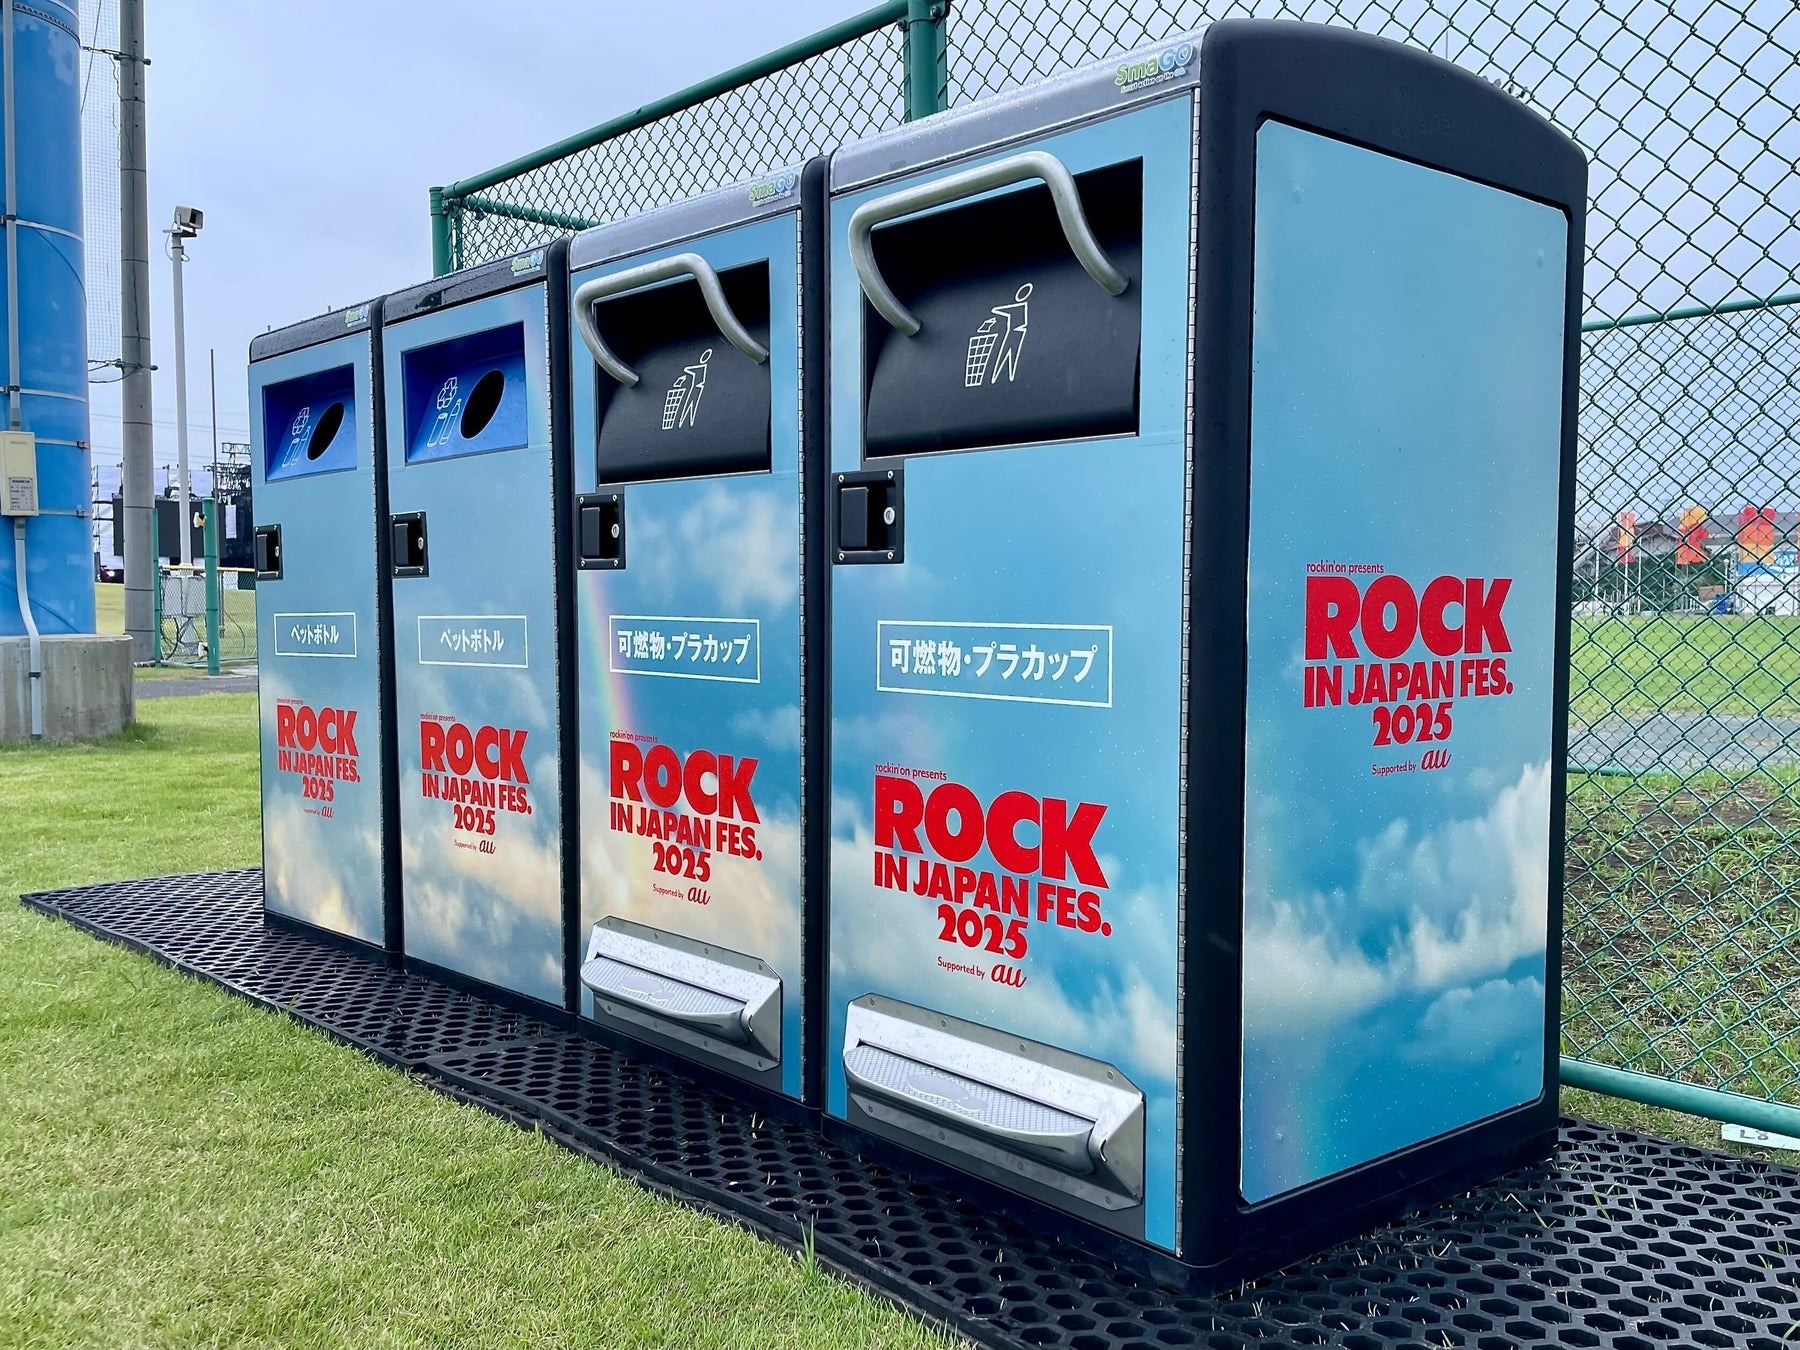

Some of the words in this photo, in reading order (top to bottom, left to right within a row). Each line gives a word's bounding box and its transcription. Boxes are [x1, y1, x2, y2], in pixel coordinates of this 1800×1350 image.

[1115, 42, 1193, 85] SmaGO
[749, 169, 796, 201] SmaGO
[1306, 560, 1346, 573] rockin'on
[1349, 563, 1384, 575] presents
[290, 624, 339, 645] ペットボトル
[1305, 575, 1513, 660] ROCK
[440, 628, 505, 653] ペットボトル
[617, 630, 752, 665] 可燃物・プラカップ
[889, 638, 1098, 683] 可燃物・プラカップ
[1304, 665, 1342, 708] IN
[1348, 660, 1455, 705] JAPAN
[1460, 658, 1514, 697] FES.
[277, 705, 359, 757] ROCK
[635, 733, 658, 743] presents
[1372, 702, 1454, 747] 2025
[278, 750, 291, 772] IN
[293, 751, 333, 778] JAPAN
[336, 757, 360, 783] FES.
[420, 721, 530, 784] ROCK
[1372, 762, 1407, 776] Supported
[1407, 762, 1417, 773] by
[1421, 748, 1452, 770] au
[302, 776, 333, 802] 2025
[610, 740, 761, 824] ROCK
[875, 763, 910, 776] rockin'on
[912, 769, 947, 781] presents
[422, 773, 439, 798] IN
[442, 776, 495, 808] JAPAN
[499, 784, 531, 815] FES.
[322, 806, 334, 818] au
[454, 804, 496, 836] 2025
[479, 840, 496, 854] au
[610, 802, 633, 833] IN
[637, 807, 711, 850] JAPAN
[716, 821, 763, 861] FES.
[875, 775, 1109, 889] ROCK
[653, 842, 711, 882] 2025
[653, 883, 677, 898] Supported
[688, 887, 711, 905] au
[874, 851, 907, 892] IN
[913, 859, 1029, 918] JAPAN
[1037, 882, 1112, 937] FES.
[938, 903, 1028, 959] 2025
[937, 956, 975, 976] Supported
[976, 966, 985, 979] by
[991, 964, 1027, 987] au
